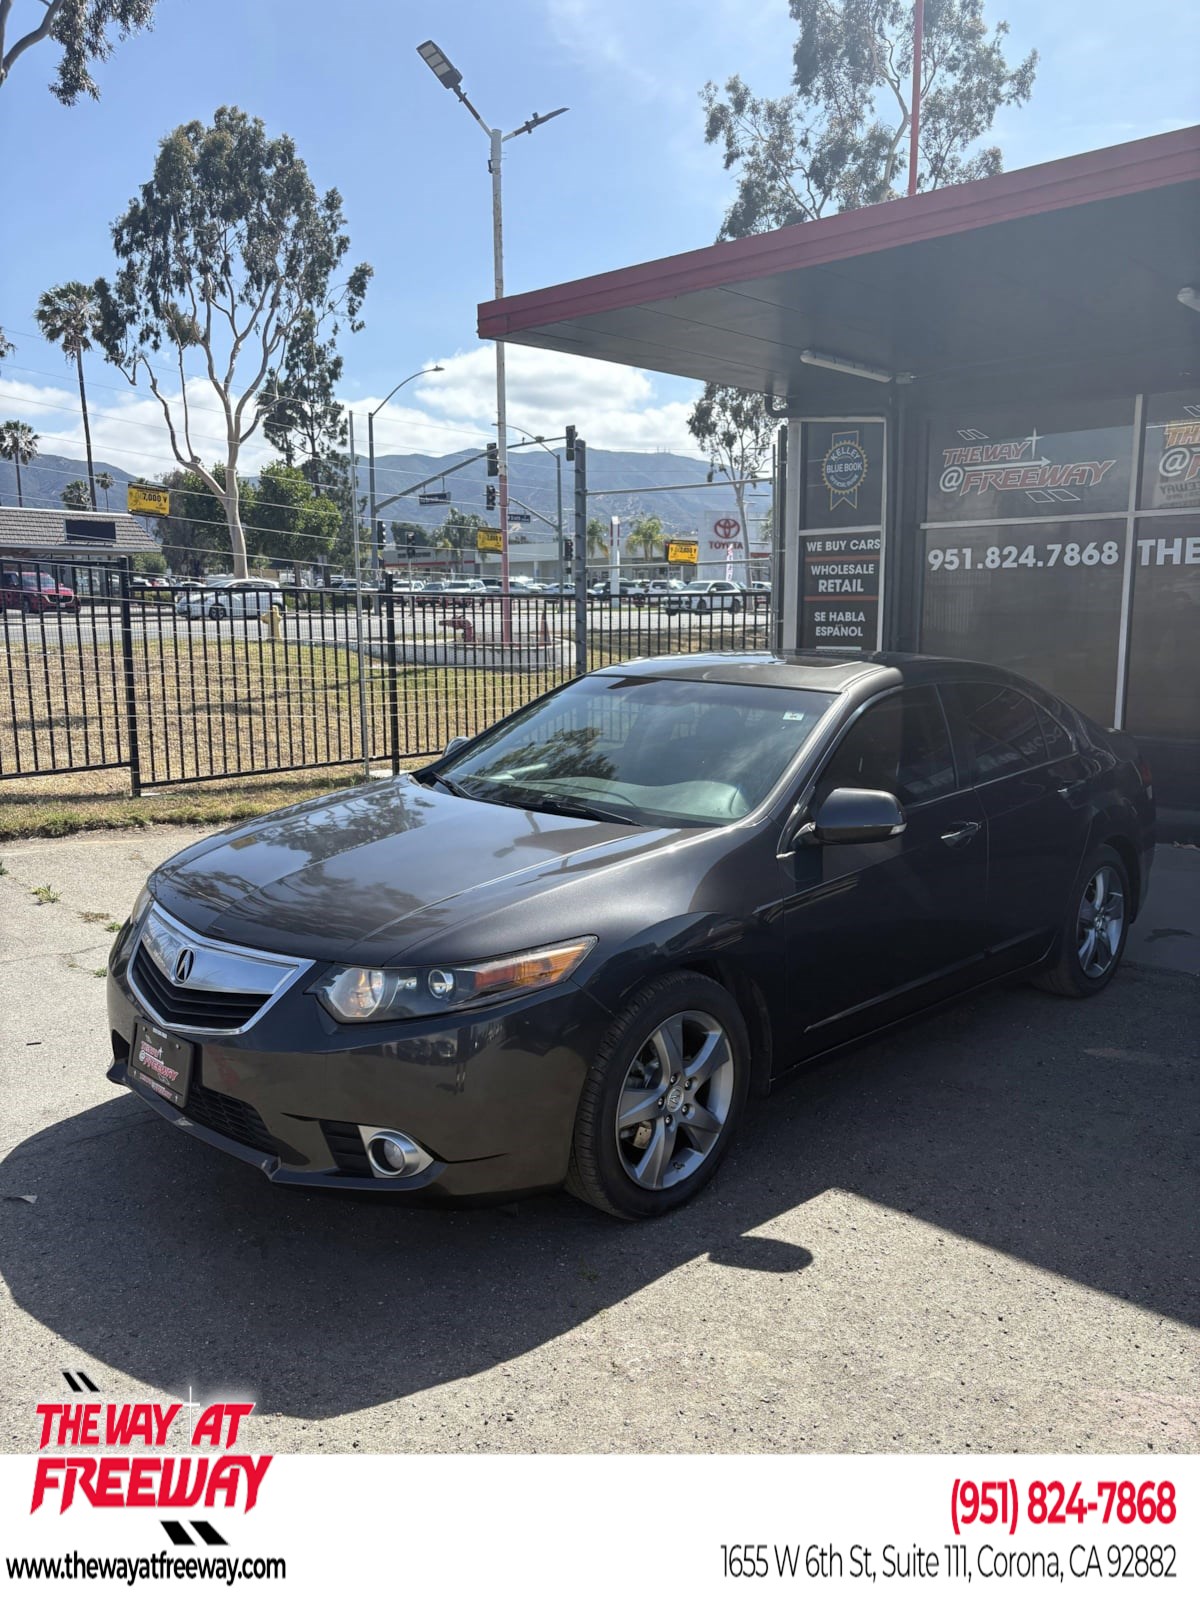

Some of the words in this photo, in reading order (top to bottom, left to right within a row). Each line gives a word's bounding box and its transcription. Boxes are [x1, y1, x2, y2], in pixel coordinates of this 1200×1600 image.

[831, 446, 861, 461] KELLEY
[826, 463, 844, 474] BLUE
[844, 461, 863, 473] BOOK
[708, 541, 744, 550] TOYTA
[806, 541, 823, 552] WE
[825, 540, 847, 551] BUY
[850, 538, 881, 550] CARS
[928, 541, 1119, 571] 951.824.7868
[811, 563, 875, 575] WHOLESALE
[818, 578, 864, 592] RETAIL
[814, 611, 826, 622] SE
[829, 611, 866, 622] HABLA
[815, 623, 863, 637] ESPAÑOL
